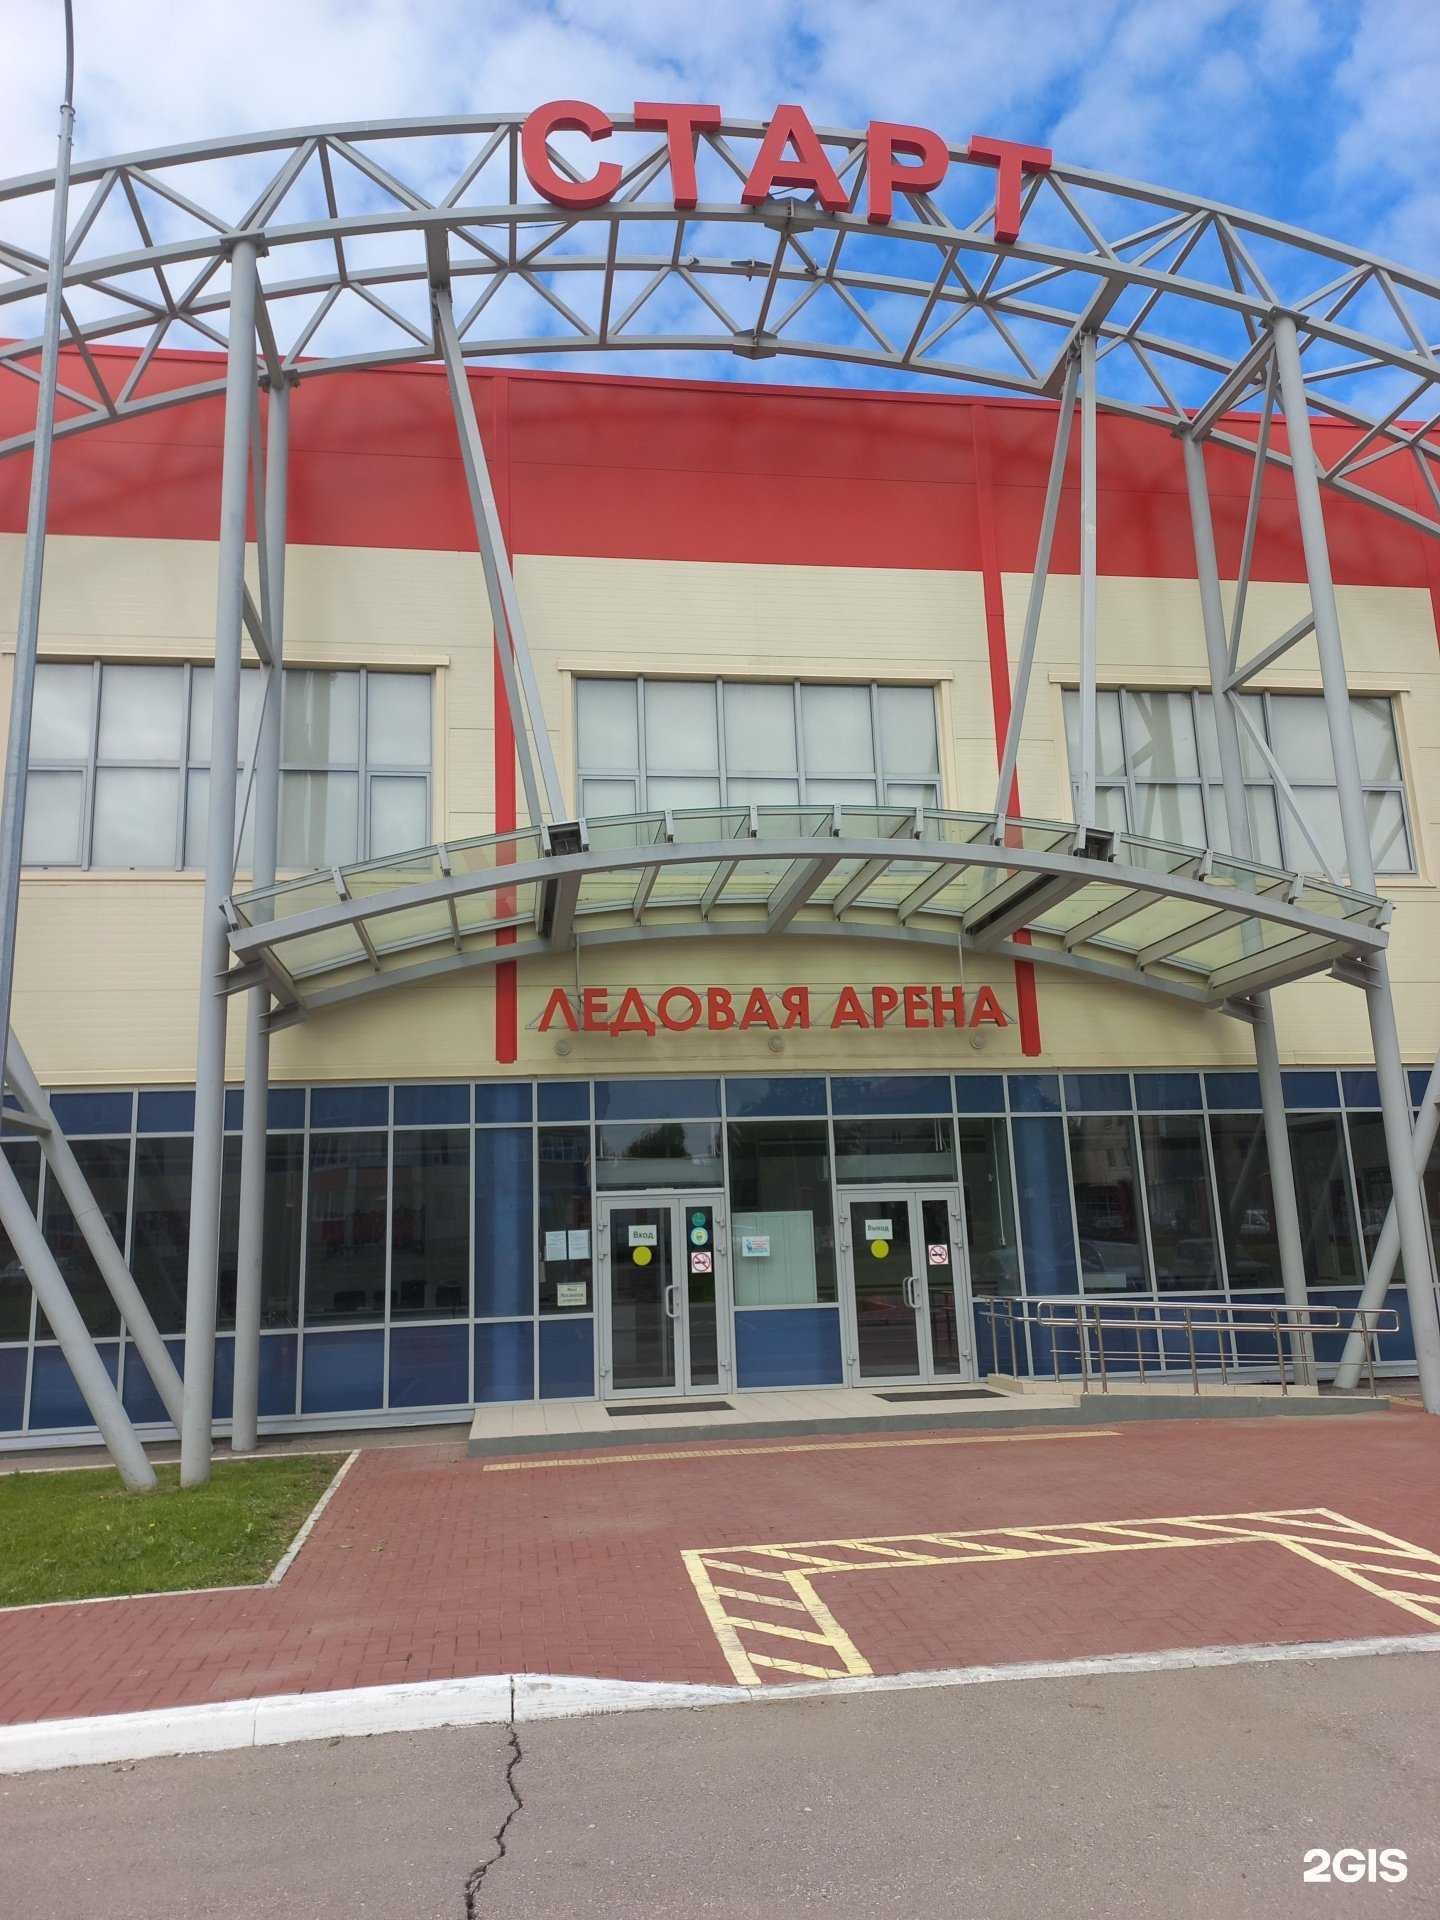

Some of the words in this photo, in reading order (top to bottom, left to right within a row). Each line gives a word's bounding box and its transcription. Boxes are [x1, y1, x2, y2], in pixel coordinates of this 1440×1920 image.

[521, 100, 1053, 243] СТАРТ
[538, 986, 810, 1036] ЛЕДОВАЯ
[831, 985, 1008, 1029] АРЕНА
[633, 1231, 655, 1239] Вход
